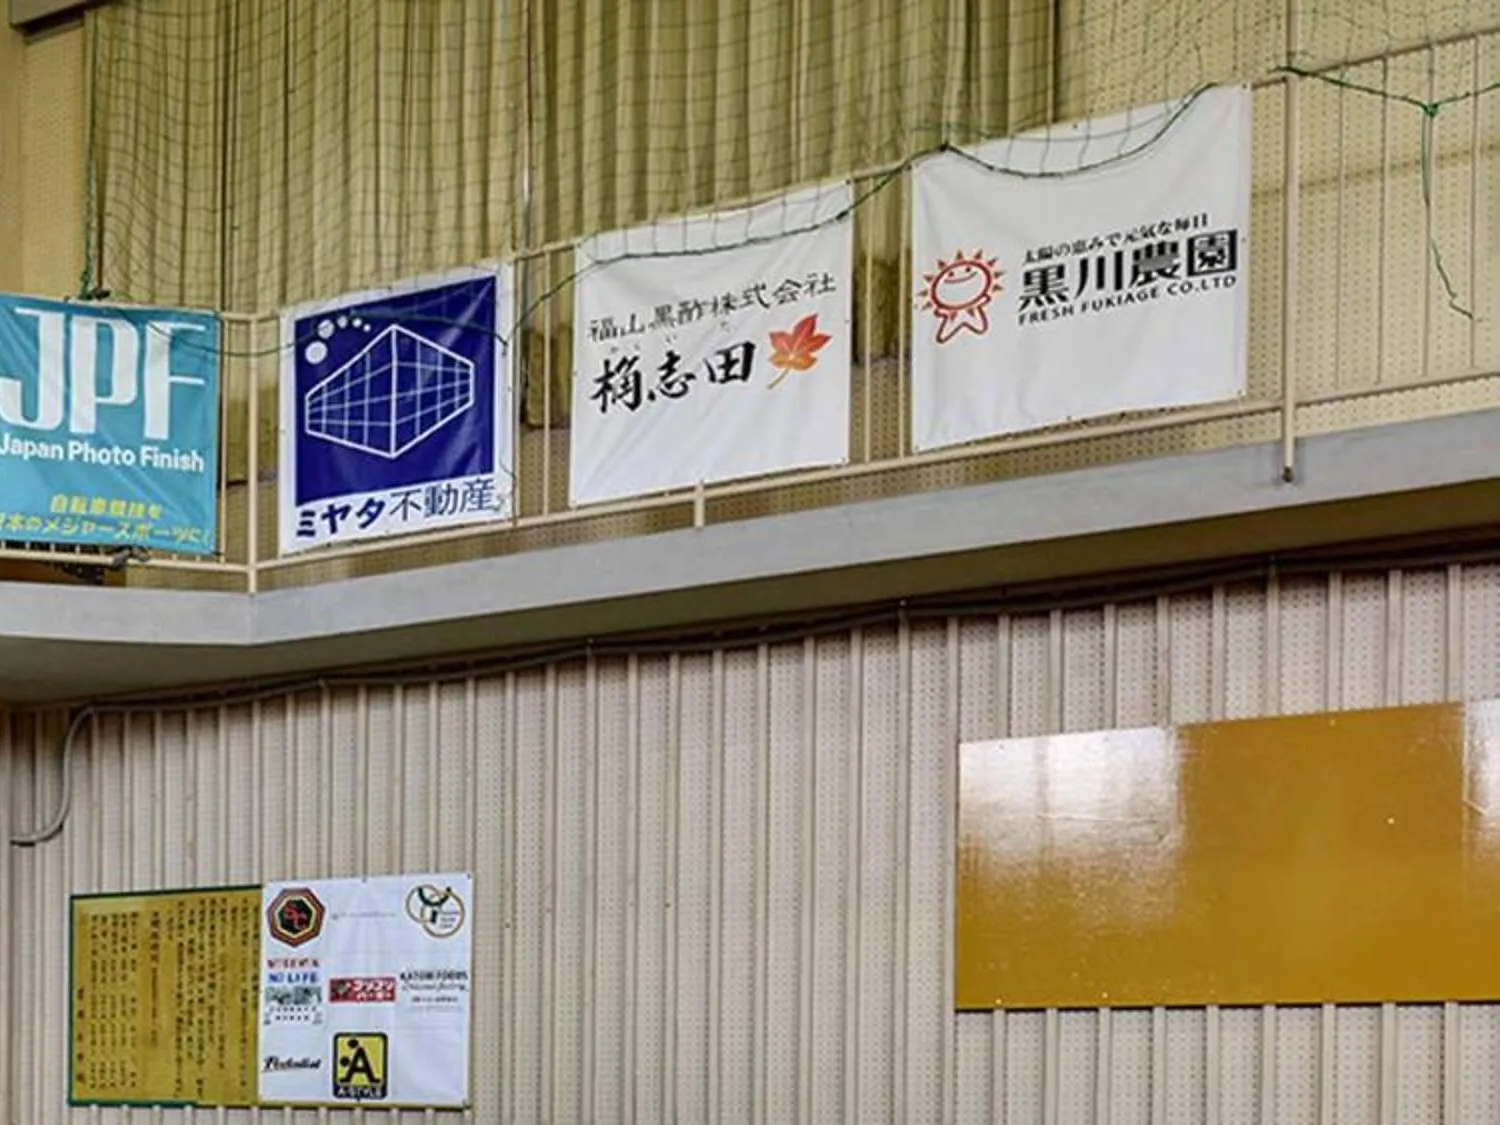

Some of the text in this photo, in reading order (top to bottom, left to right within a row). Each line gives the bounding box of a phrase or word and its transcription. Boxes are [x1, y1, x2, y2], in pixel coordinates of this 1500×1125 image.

[1018, 229, 1238, 313] 黒川農園
[587, 272, 838, 342] 福山黒酢株式会社
[1018, 306, 1075, 326] FRESH
[1081, 286, 1159, 314] FUKIAGE
[67, 440, 136, 466] Photo
[140, 445, 204, 473] Finish
[296, 477, 495, 537] ミヤタ不動産
